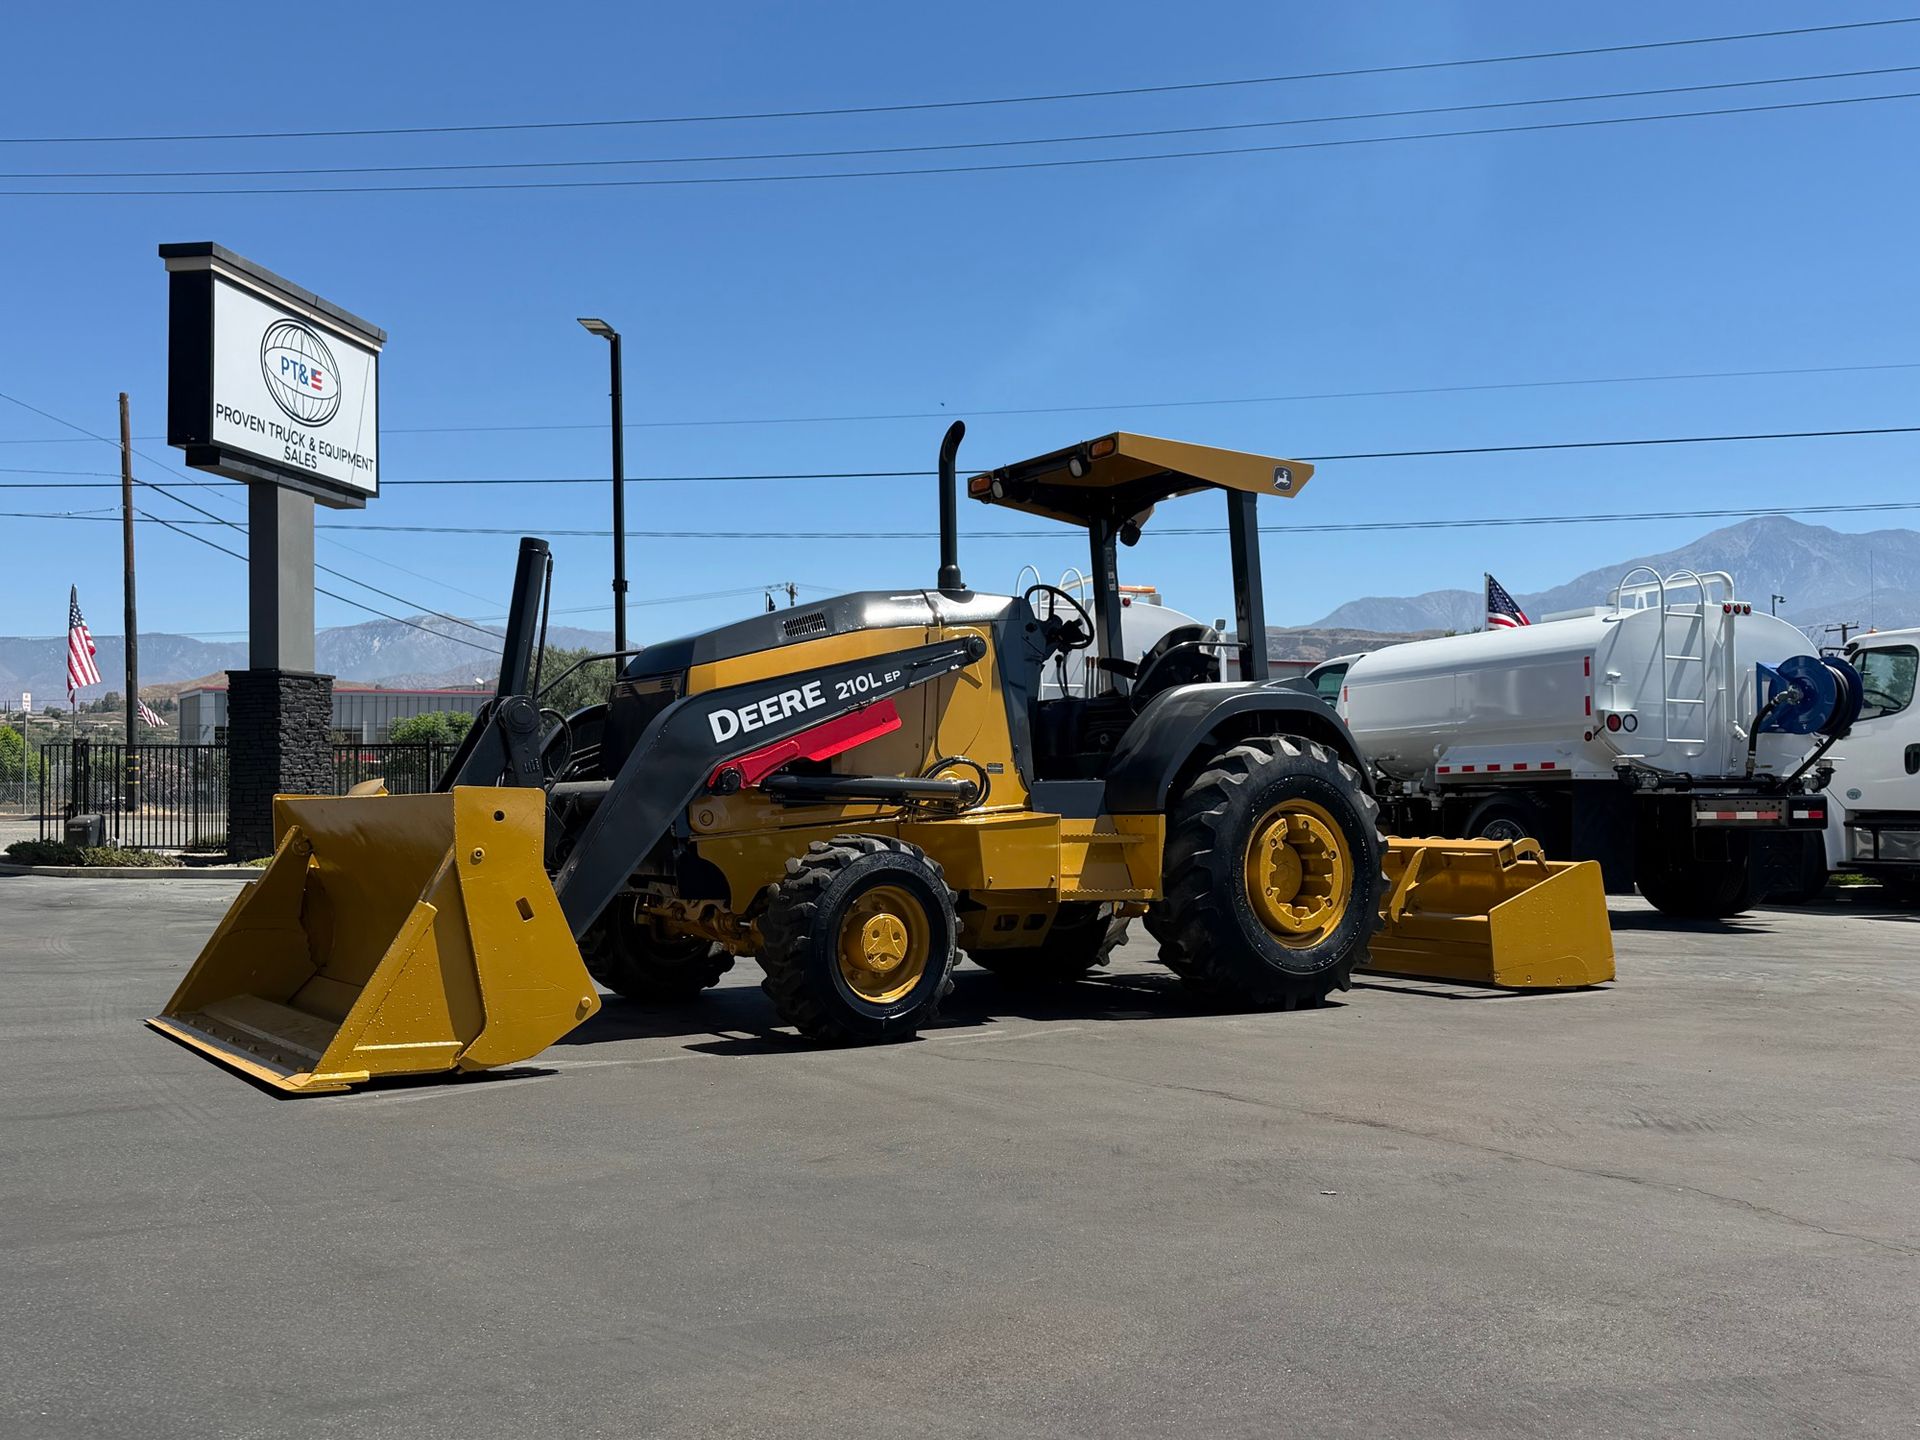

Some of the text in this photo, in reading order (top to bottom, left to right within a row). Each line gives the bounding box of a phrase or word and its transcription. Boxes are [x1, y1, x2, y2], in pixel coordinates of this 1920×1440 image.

[216, 403, 374, 473] PROVEN TRUCK & EQUIPMENT
[284, 446, 318, 469] SALES
[708, 670, 901, 743] DEERE 210L EP
